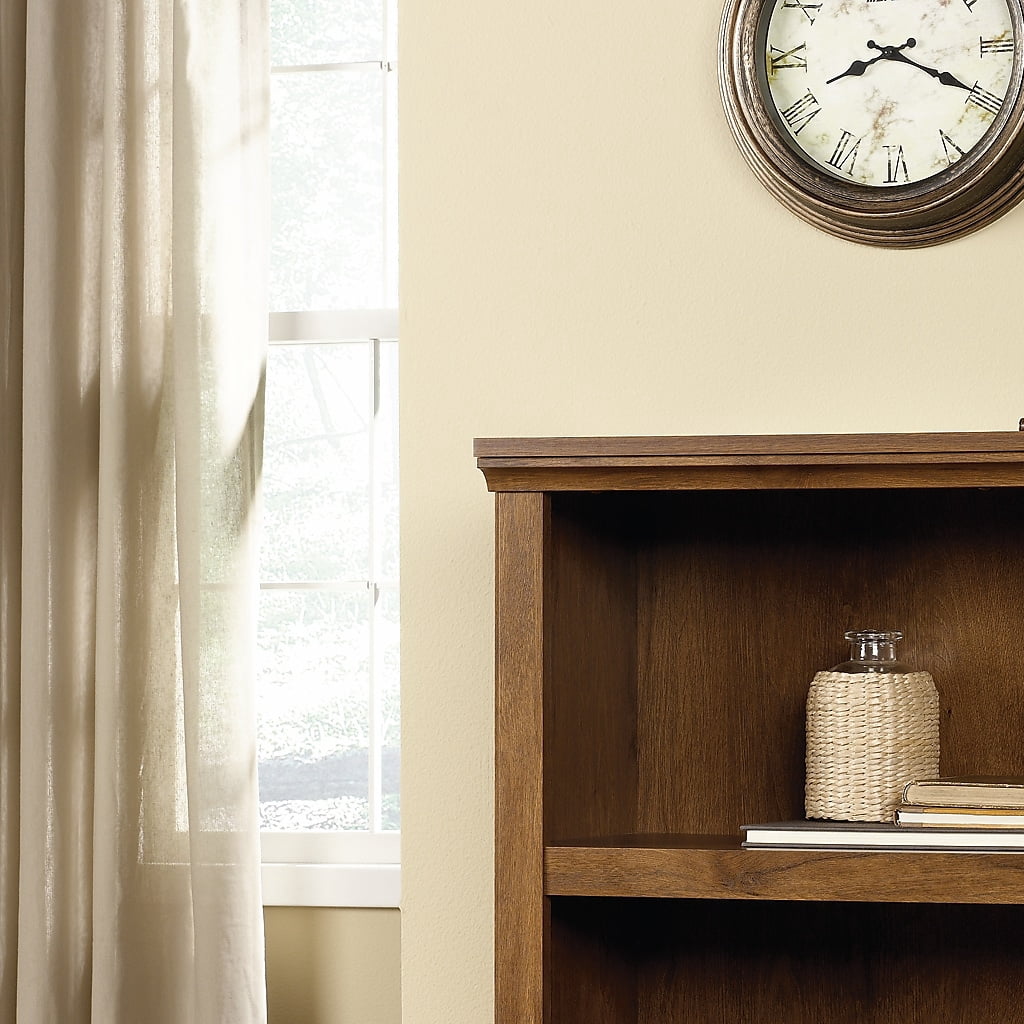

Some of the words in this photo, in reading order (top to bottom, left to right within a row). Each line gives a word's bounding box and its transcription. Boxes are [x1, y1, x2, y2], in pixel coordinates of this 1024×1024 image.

[770, 41, 808, 75] IX
[979, 36, 1014, 58] III
[779, 88, 822, 136] VIII
[825, 128, 862, 176] VII
[882, 144, 910, 183] VI
